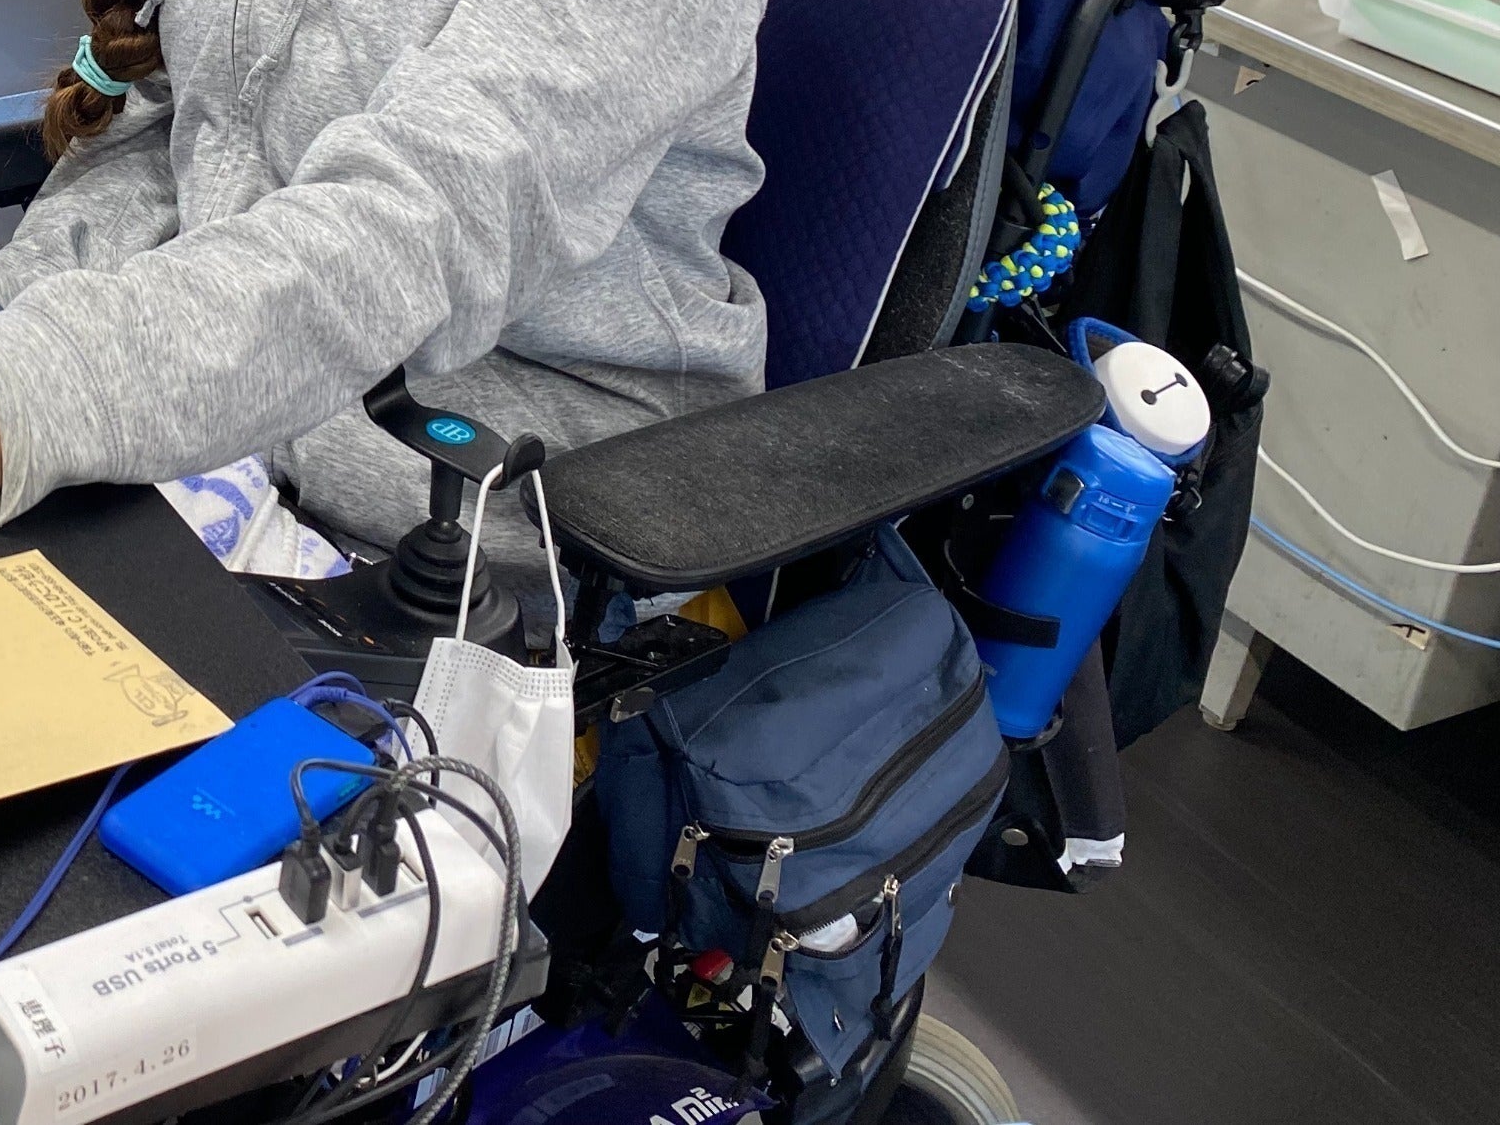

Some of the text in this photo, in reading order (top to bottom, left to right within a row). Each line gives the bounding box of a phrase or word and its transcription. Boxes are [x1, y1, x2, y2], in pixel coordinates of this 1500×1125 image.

[155, 934, 189, 951] Total
[92, 939, 219, 996] 5 Ports USB
